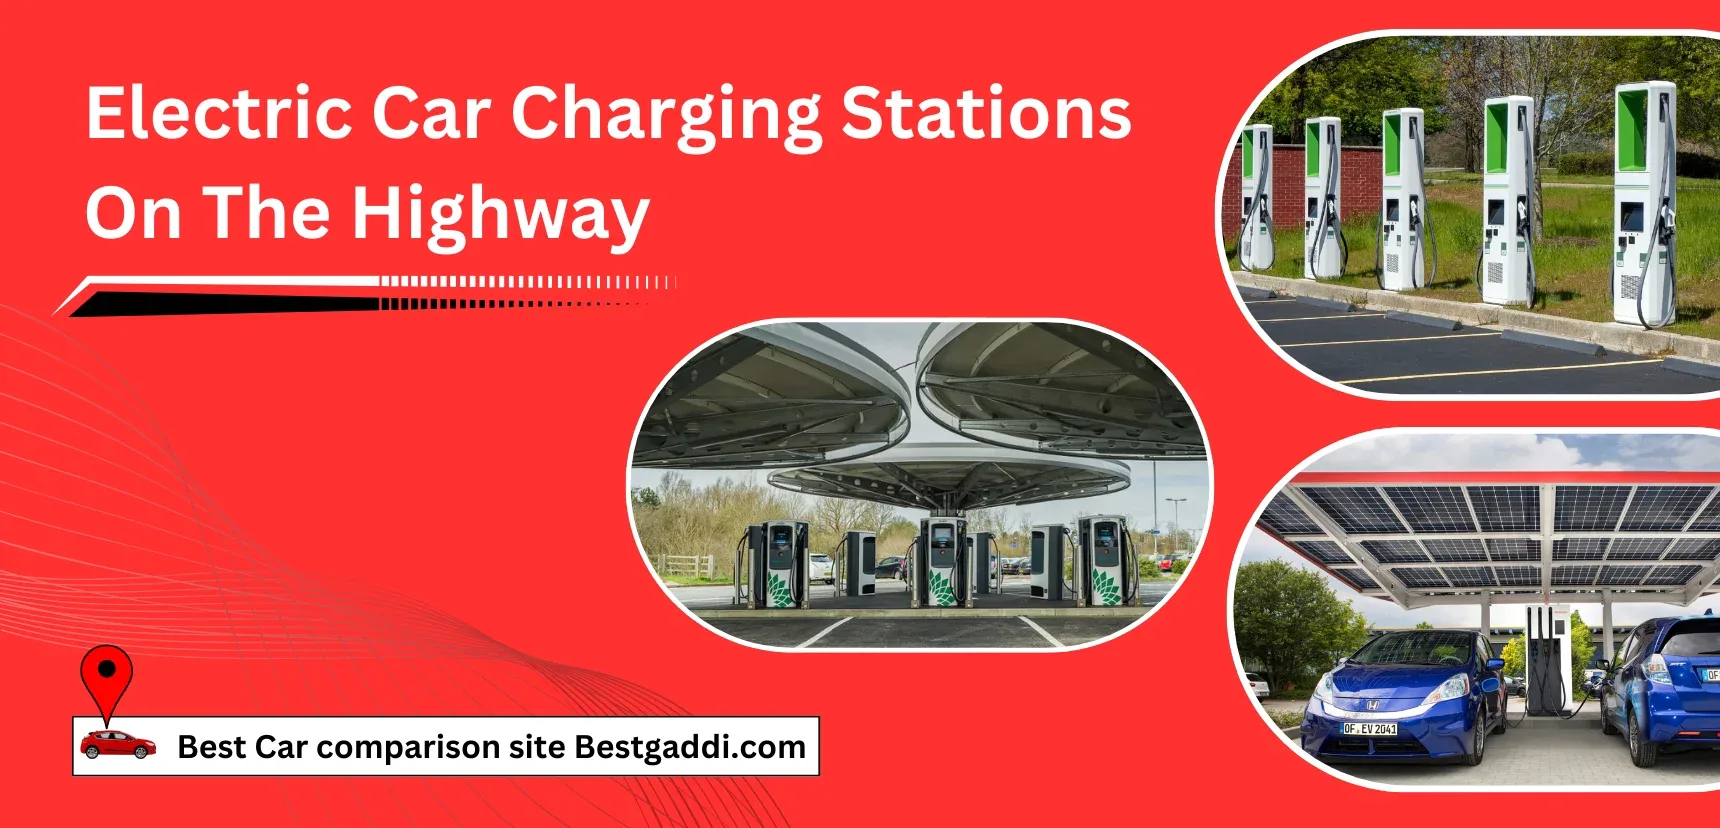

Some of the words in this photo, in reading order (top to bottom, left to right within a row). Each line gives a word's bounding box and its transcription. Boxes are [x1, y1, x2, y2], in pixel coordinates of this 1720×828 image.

[1344, 723, 1356, 734] OF
[1361, 724, 1373, 734] EV
[1375, 724, 1397, 735] 2041
